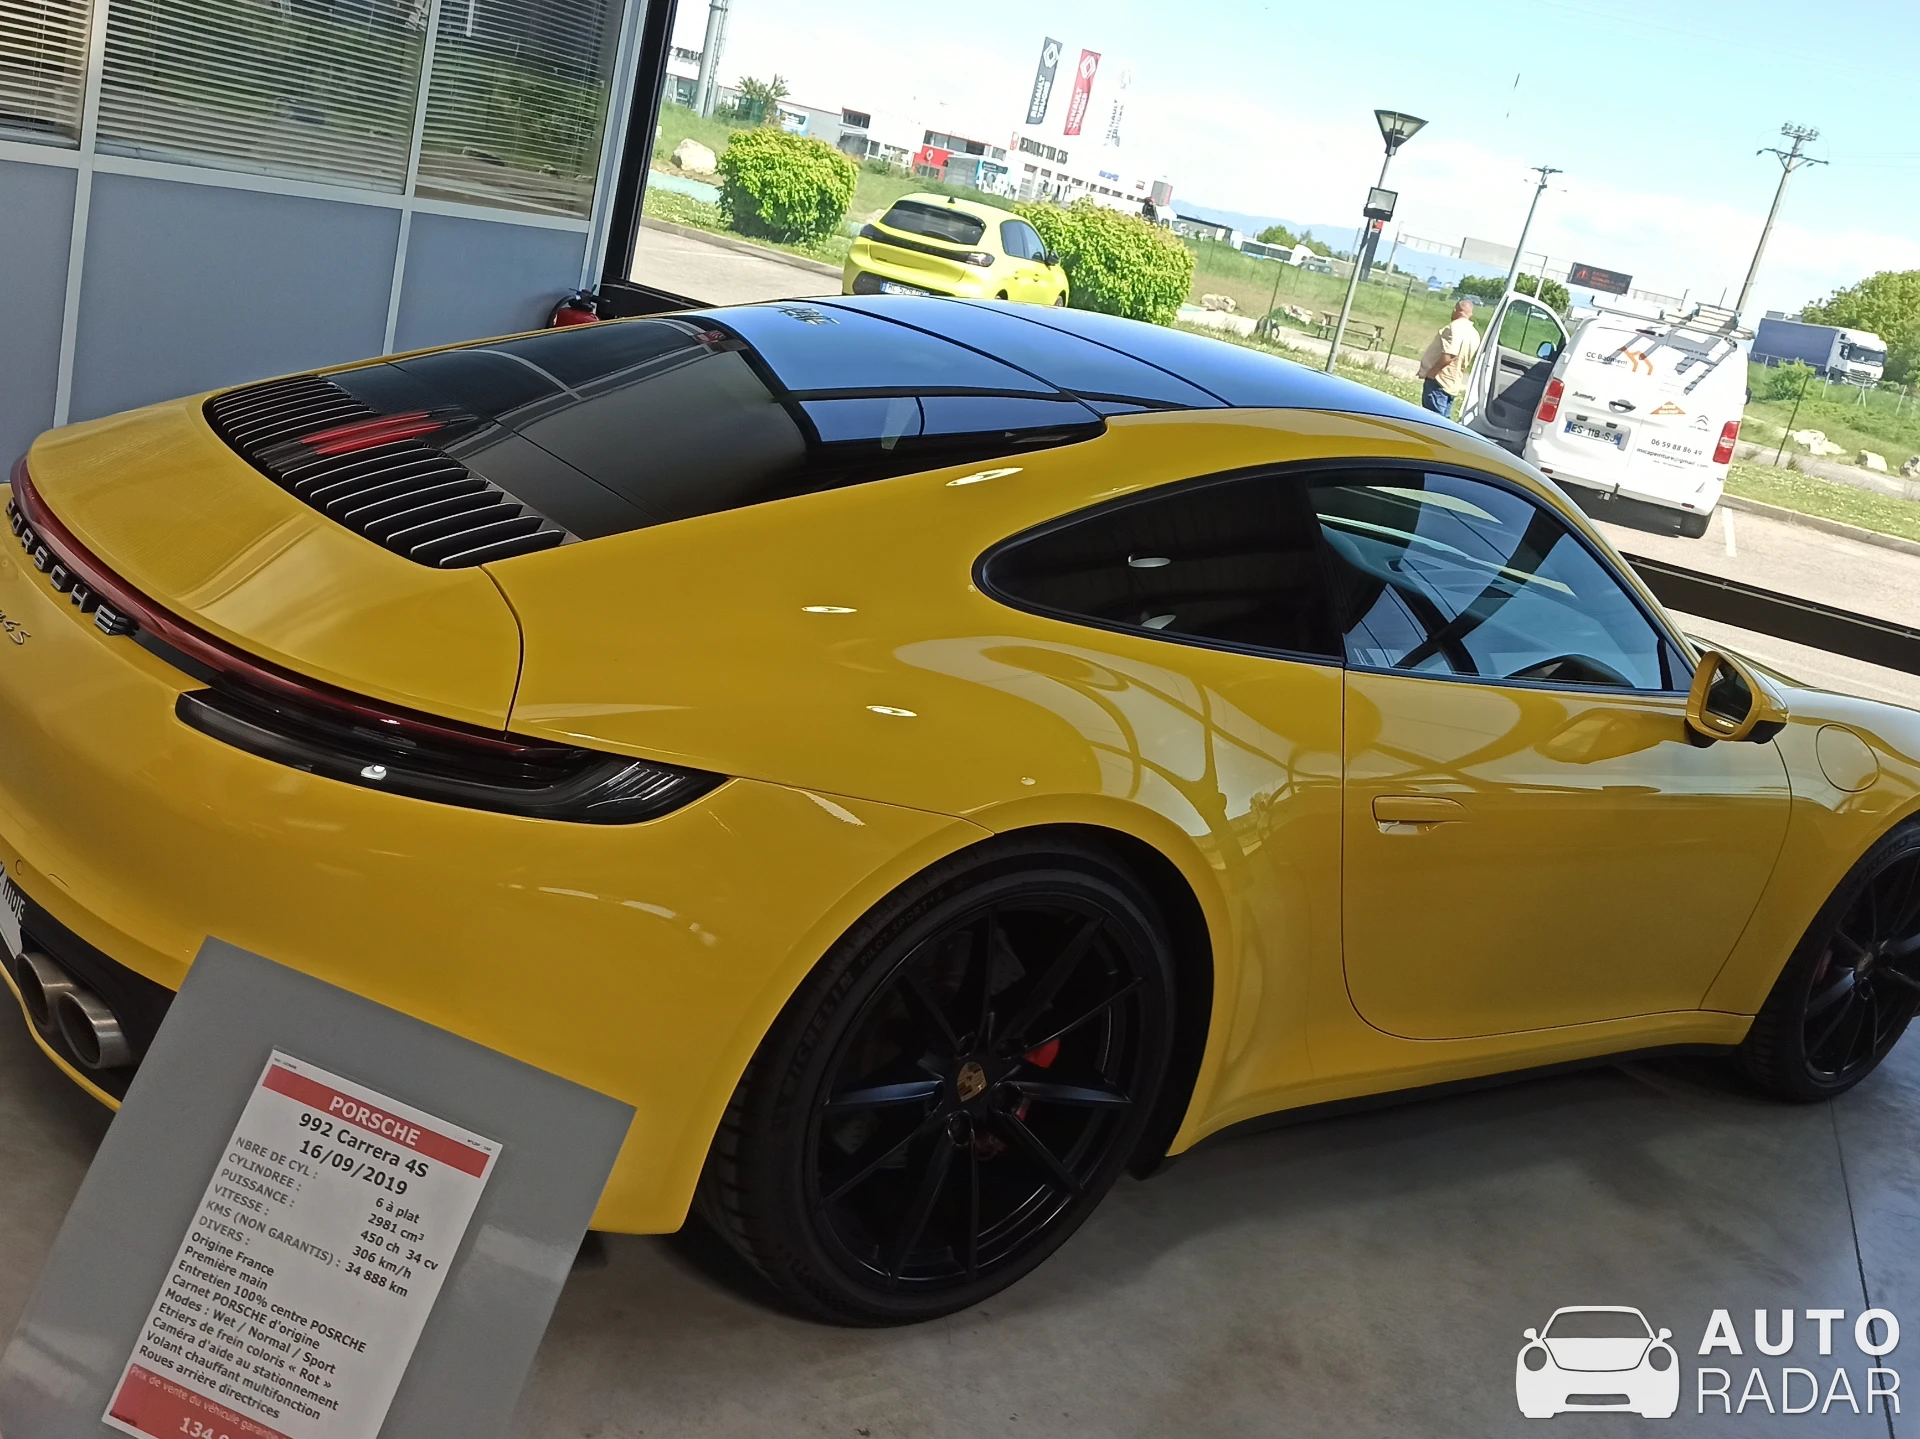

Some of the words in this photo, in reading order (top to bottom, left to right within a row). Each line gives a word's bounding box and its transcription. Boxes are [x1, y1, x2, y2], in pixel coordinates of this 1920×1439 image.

[1030, 74, 1046, 118] RENAULT
[1586, 352, 1597, 360] CC
[1651, 438, 1661, 446] 06
[6, 497, 119, 635] PORSCHE
[860, 932, 888, 967] PILOT
[892, 900, 929, 934] SPORT
[298, 1113, 333, 1138] 992
[337, 1129, 400, 1166] Carrera
[404, 1158, 430, 1178] 4S
[329, 1096, 420, 1146] PORSCHE
[228, 1152, 295, 1188] CYLINDREE
[368, 1213, 398, 1233] 2981
[236, 1137, 268, 1157] NBRE
[269, 1151, 286, 1165] DE
[288, 1160, 310, 1176] CYL
[376, 1198, 385, 1207] 6
[386, 1201, 394, 1212] à
[395, 1208, 420, 1224] plat
[299, 1140, 408, 1196] 16/09/2019
[192, 1232, 234, 1258] Origine
[236, 1252, 274, 1277] France
[199, 1216, 244, 1242] DIVERS
[206, 1200, 232, 1218] KMS
[234, 1212, 266, 1233] (NON
[268, 1228, 334, 1265] GARANTIS)
[345, 1262, 361, 1276] 34
[363, 1270, 387, 1287] 888
[389, 1280, 408, 1297] km
[214, 1184, 263, 1212] VITESSE
[352, 1246, 377, 1262] 306
[378, 1256, 412, 1279] km/h
[221, 1168, 288, 1204] PUISSANCE
[360, 1230, 384, 1246] 450
[386, 1242, 400, 1254] ch
[406, 1250, 422, 1263] 34
[424, 1259, 439, 1270] cv
[185, 1246, 236, 1277] Première
[239, 1272, 268, 1291] main
[158, 1302, 197, 1327] Etriers
[200, 1322, 215, 1335] de
[216, 1328, 244, 1349] frein
[247, 1345, 285, 1368] coloris
[299, 1368, 321, 1385] Rot
[165, 1288, 203, 1312] Modes
[213, 1309, 236, 1327] Wet
[248, 1326, 292, 1353] Normal
[302, 1352, 336, 1374] Sport
[172, 1275, 211, 1298] Carnet
[212, 1292, 268, 1324] PORSCHE
[269, 1319, 320, 1350] d'origine
[178, 1260, 231, 1290] Entretien
[234, 1286, 268, 1308] 100%
[270, 1304, 308, 1327] centre
[310, 1320, 367, 1353] POSRCHE
[139, 1345, 175, 1368] Roues
[176, 1364, 216, 1388] arrière
[218, 1384, 281, 1419] directrices
[146, 1330, 183, 1355] Volant
[185, 1350, 240, 1383] chauffant
[243, 1376, 321, 1419] multifonction
[149, 1374, 162, 1387] de
[163, 1382, 188, 1400] vente
[189, 1395, 201, 1406] du
[204, 1400, 240, 1425] véhicule
[153, 1317, 195, 1344] Caméra
[198, 1338, 234, 1362] d'aide
[236, 1358, 250, 1369] au
[253, 1364, 339, 1411] stationnement
